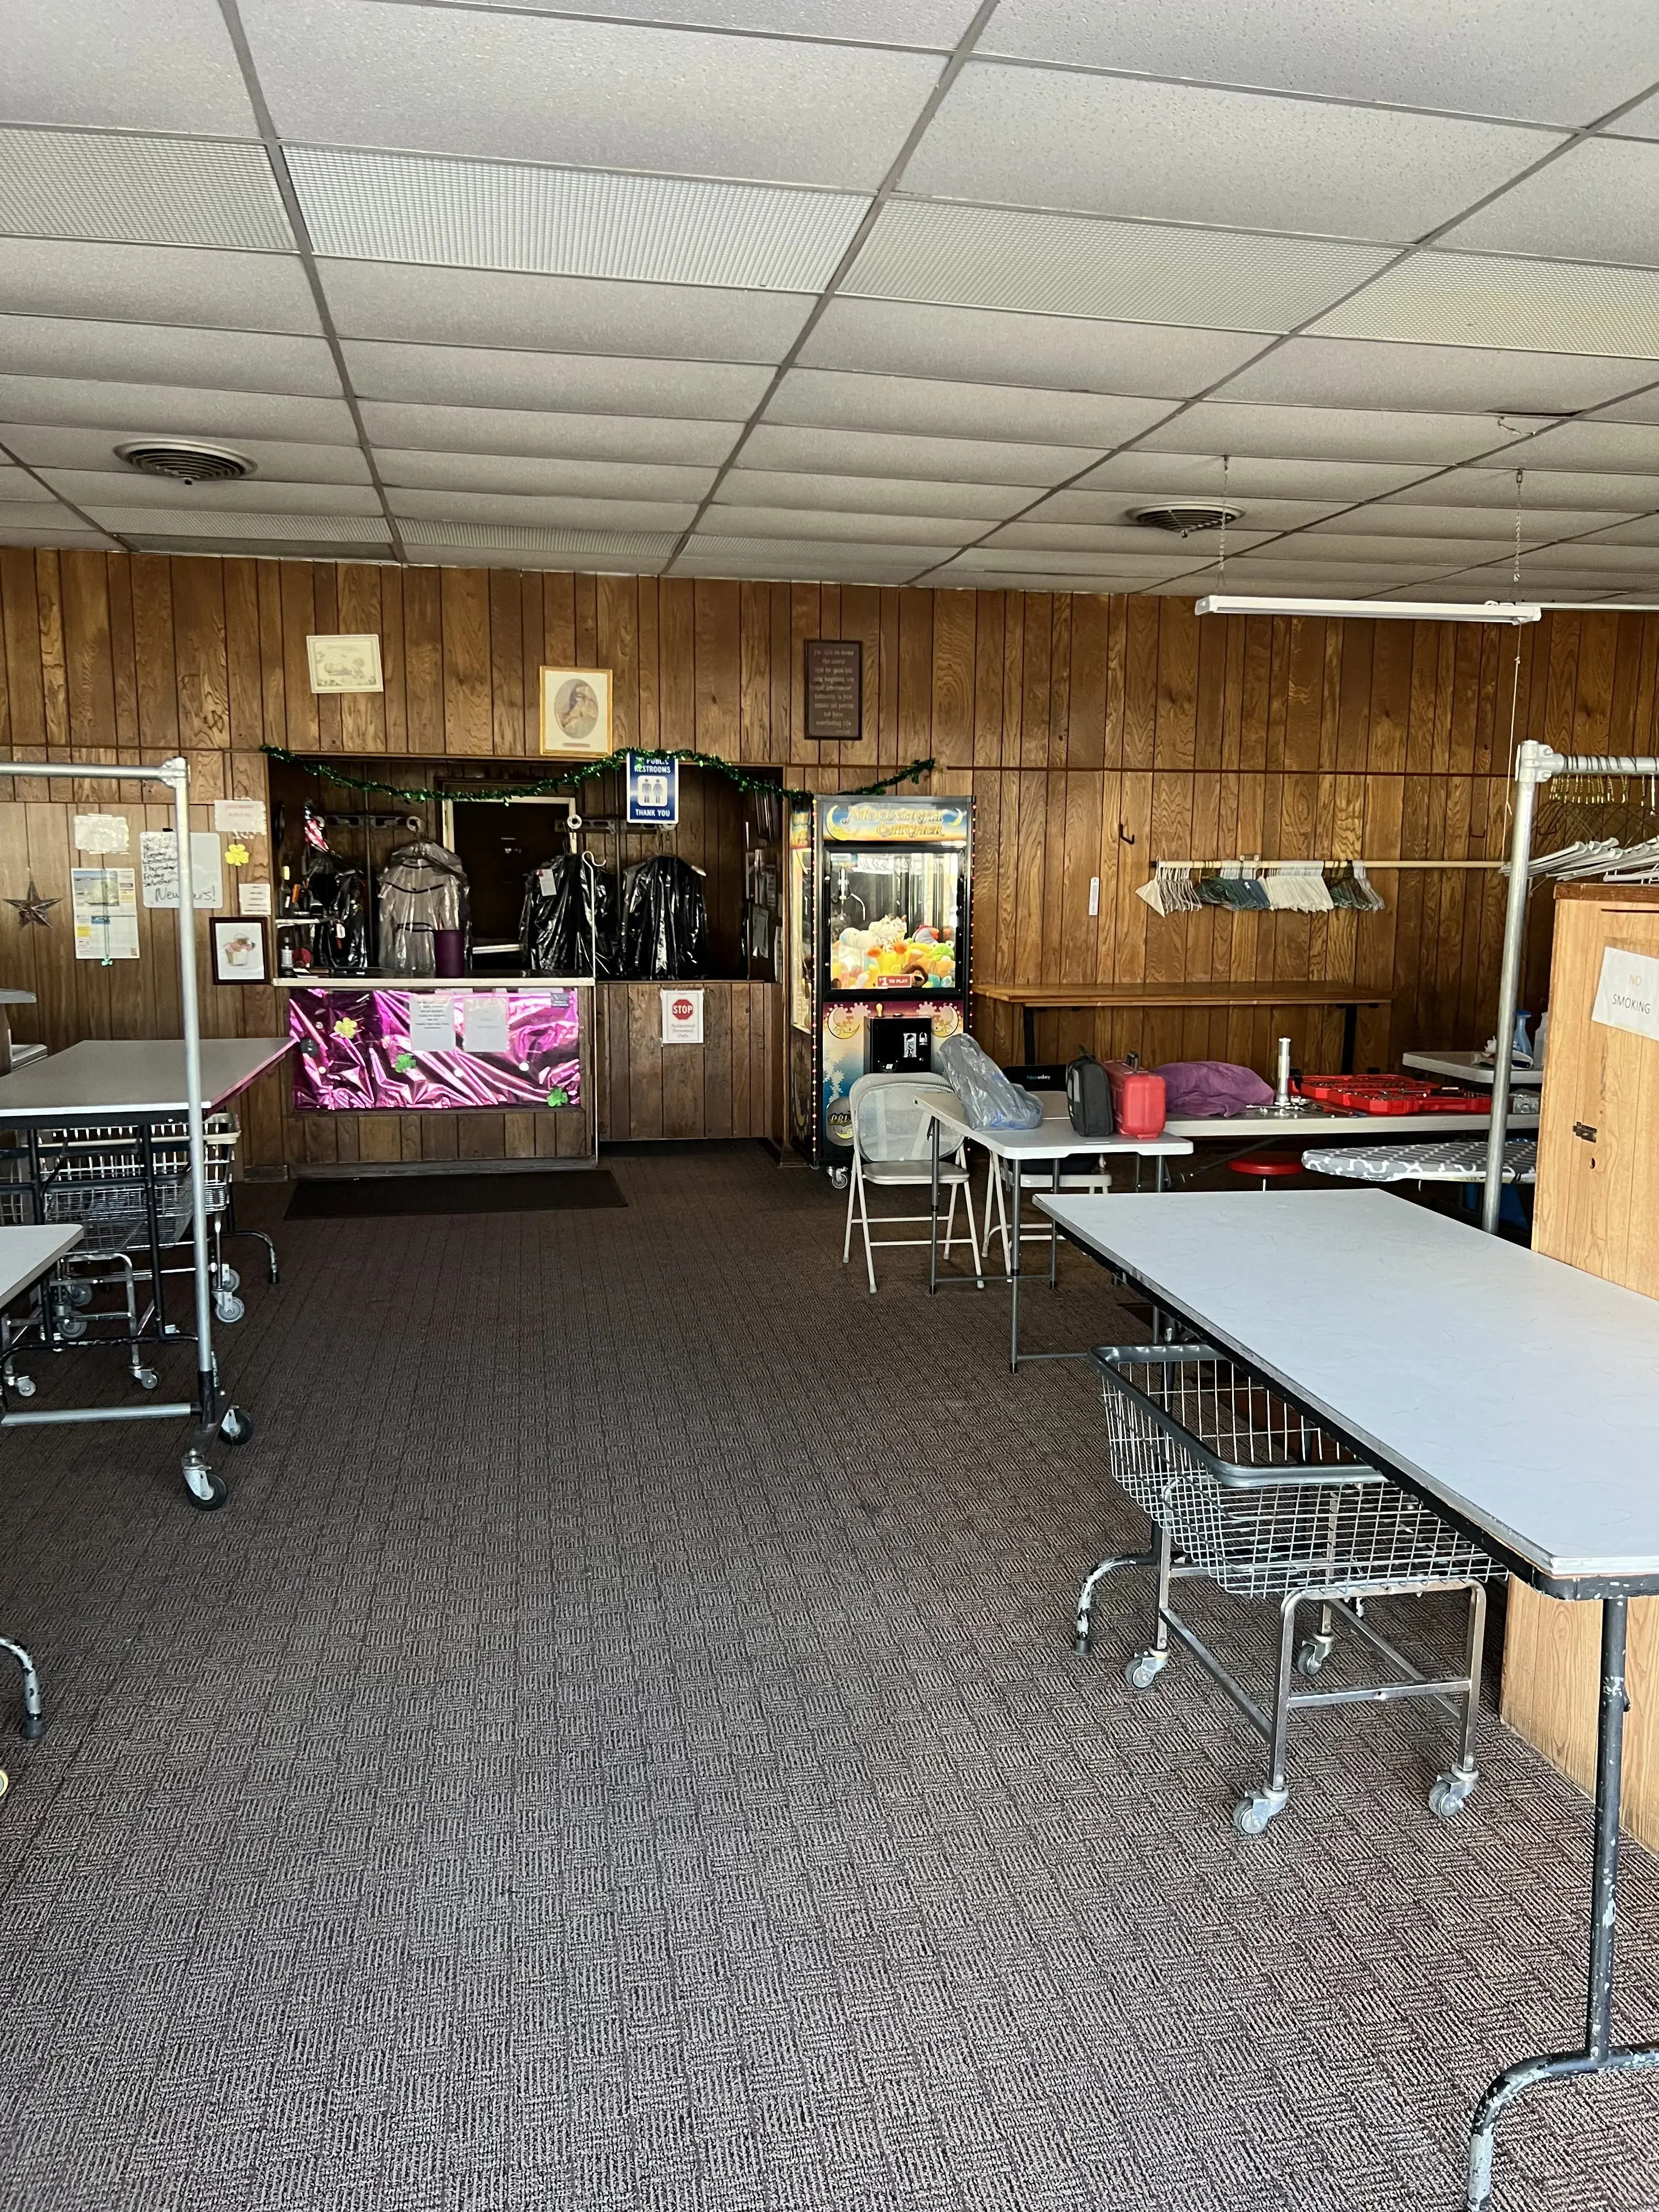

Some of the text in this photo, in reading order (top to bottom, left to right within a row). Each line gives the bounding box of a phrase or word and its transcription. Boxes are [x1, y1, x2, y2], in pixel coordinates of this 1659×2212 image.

[1629, 974, 1642, 986] NO
[673, 1005, 693, 1014] STOP
[1612, 994, 1651, 1014] SMOKING
